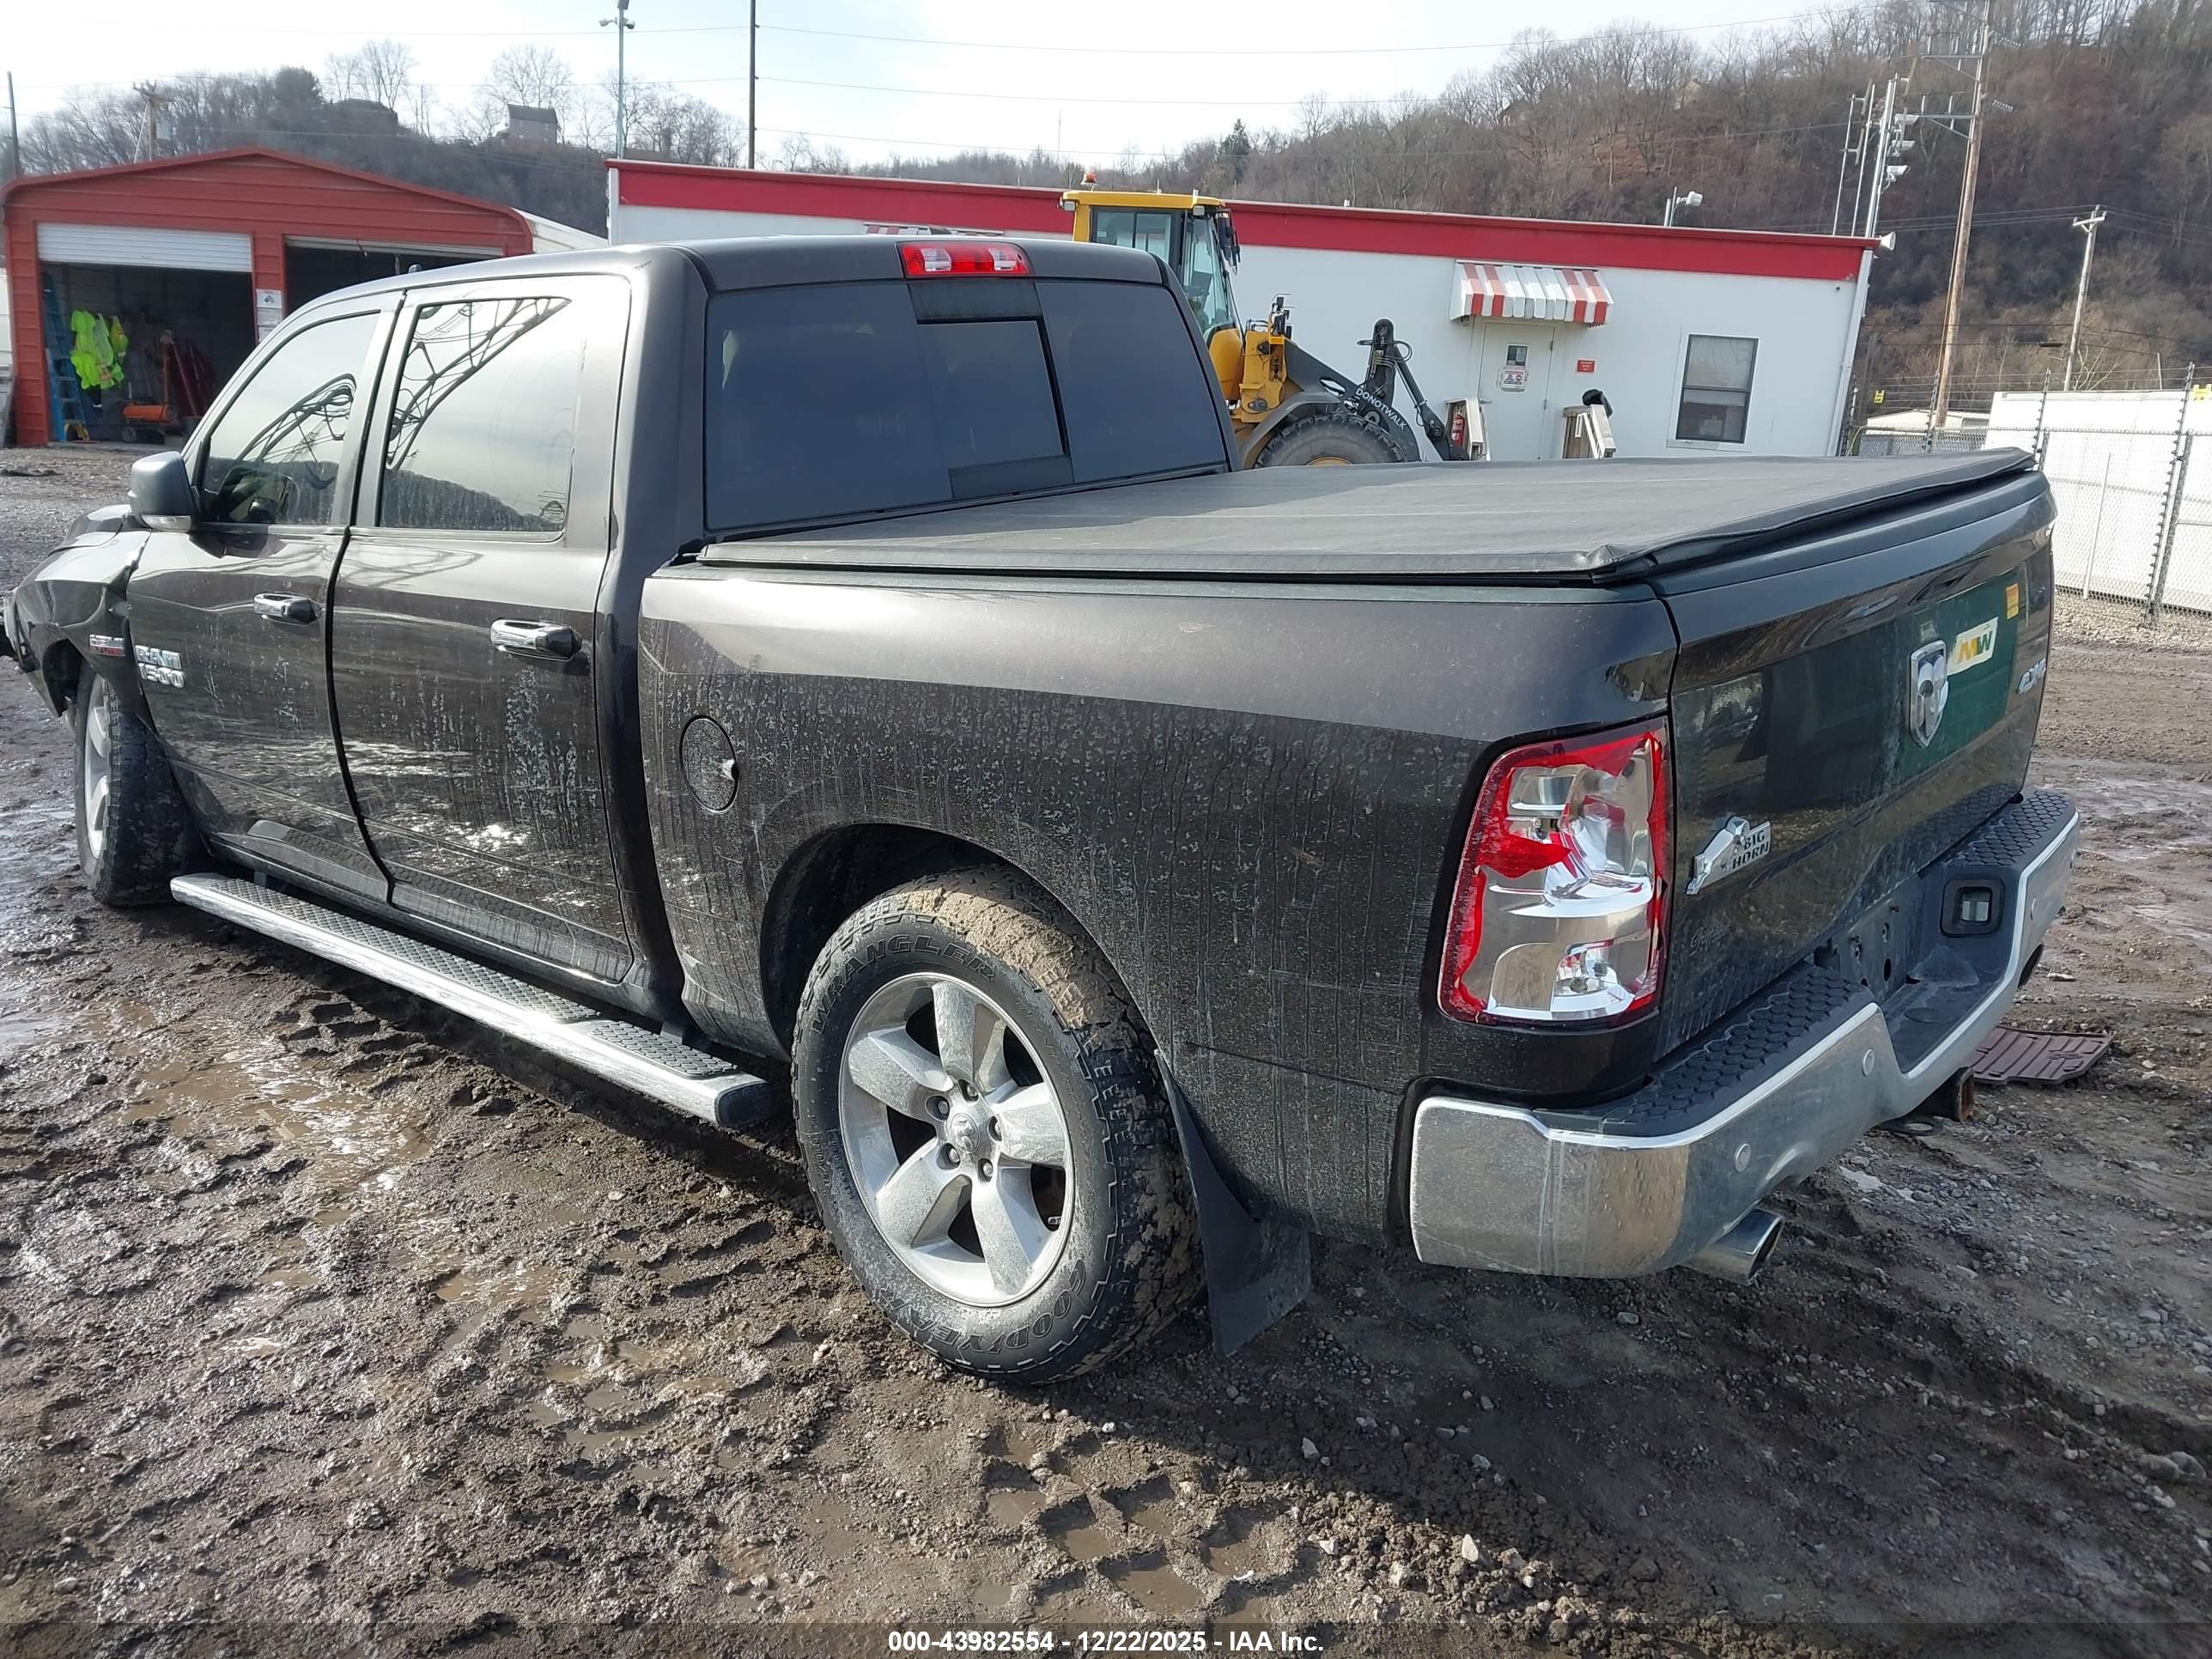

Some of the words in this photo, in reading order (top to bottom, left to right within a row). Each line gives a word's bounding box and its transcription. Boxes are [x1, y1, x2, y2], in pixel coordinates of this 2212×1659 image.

[135, 645, 182, 670] RAM
[138, 663, 185, 688] 1500
[1744, 830, 1765, 850] BIG
[1732, 841, 1769, 870] HORN
[811, 934, 996, 1032] WRANGLER
